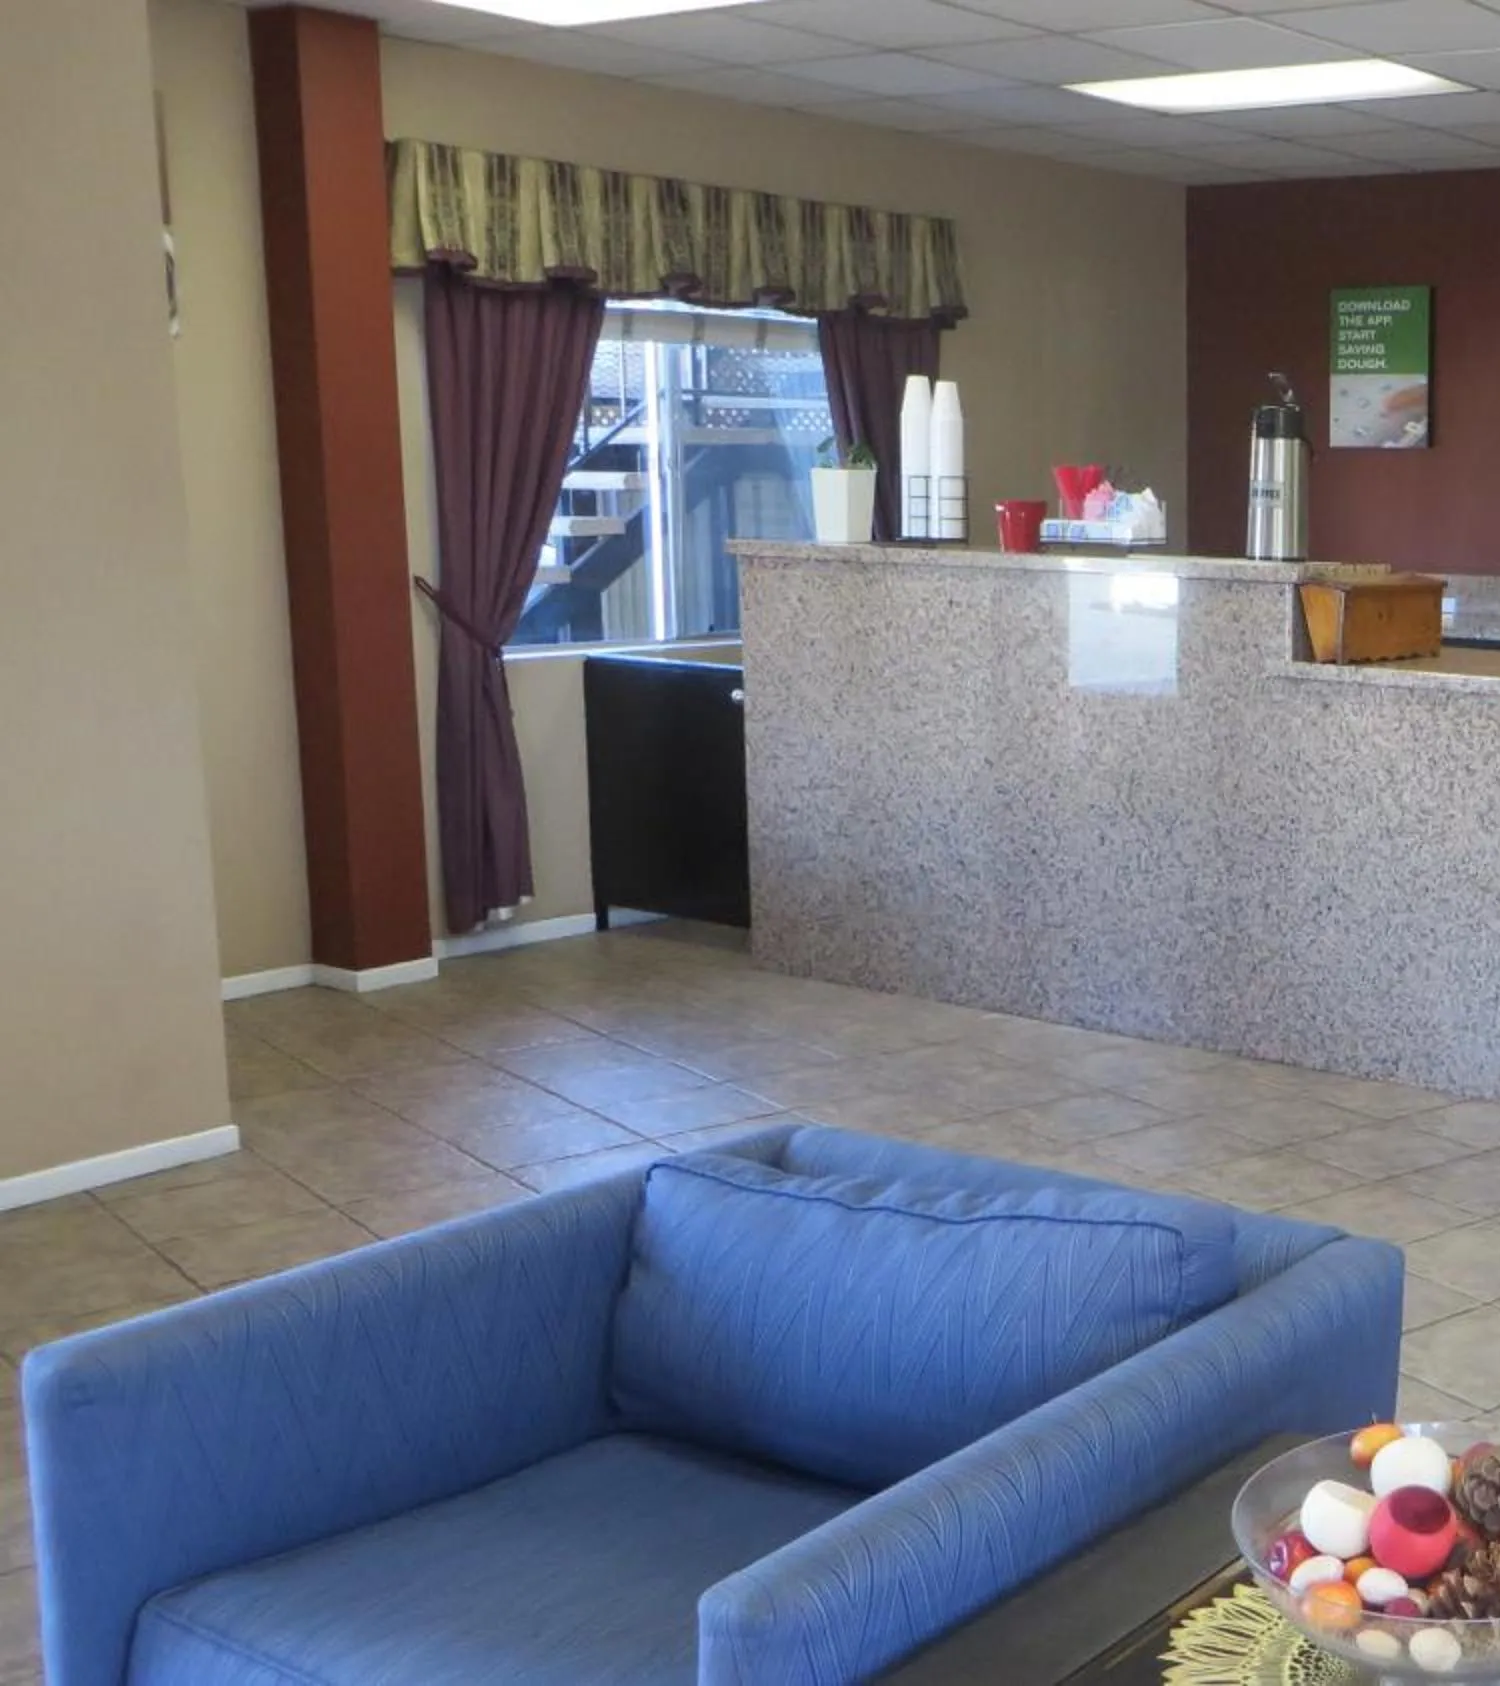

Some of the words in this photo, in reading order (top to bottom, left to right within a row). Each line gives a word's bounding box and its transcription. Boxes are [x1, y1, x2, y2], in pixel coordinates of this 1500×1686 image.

[1338, 300, 1411, 312] DOWNLOAD
[1340, 315, 1364, 328] THE
[1338, 329, 1376, 341] START
[1338, 344, 1385, 354] SAVING
